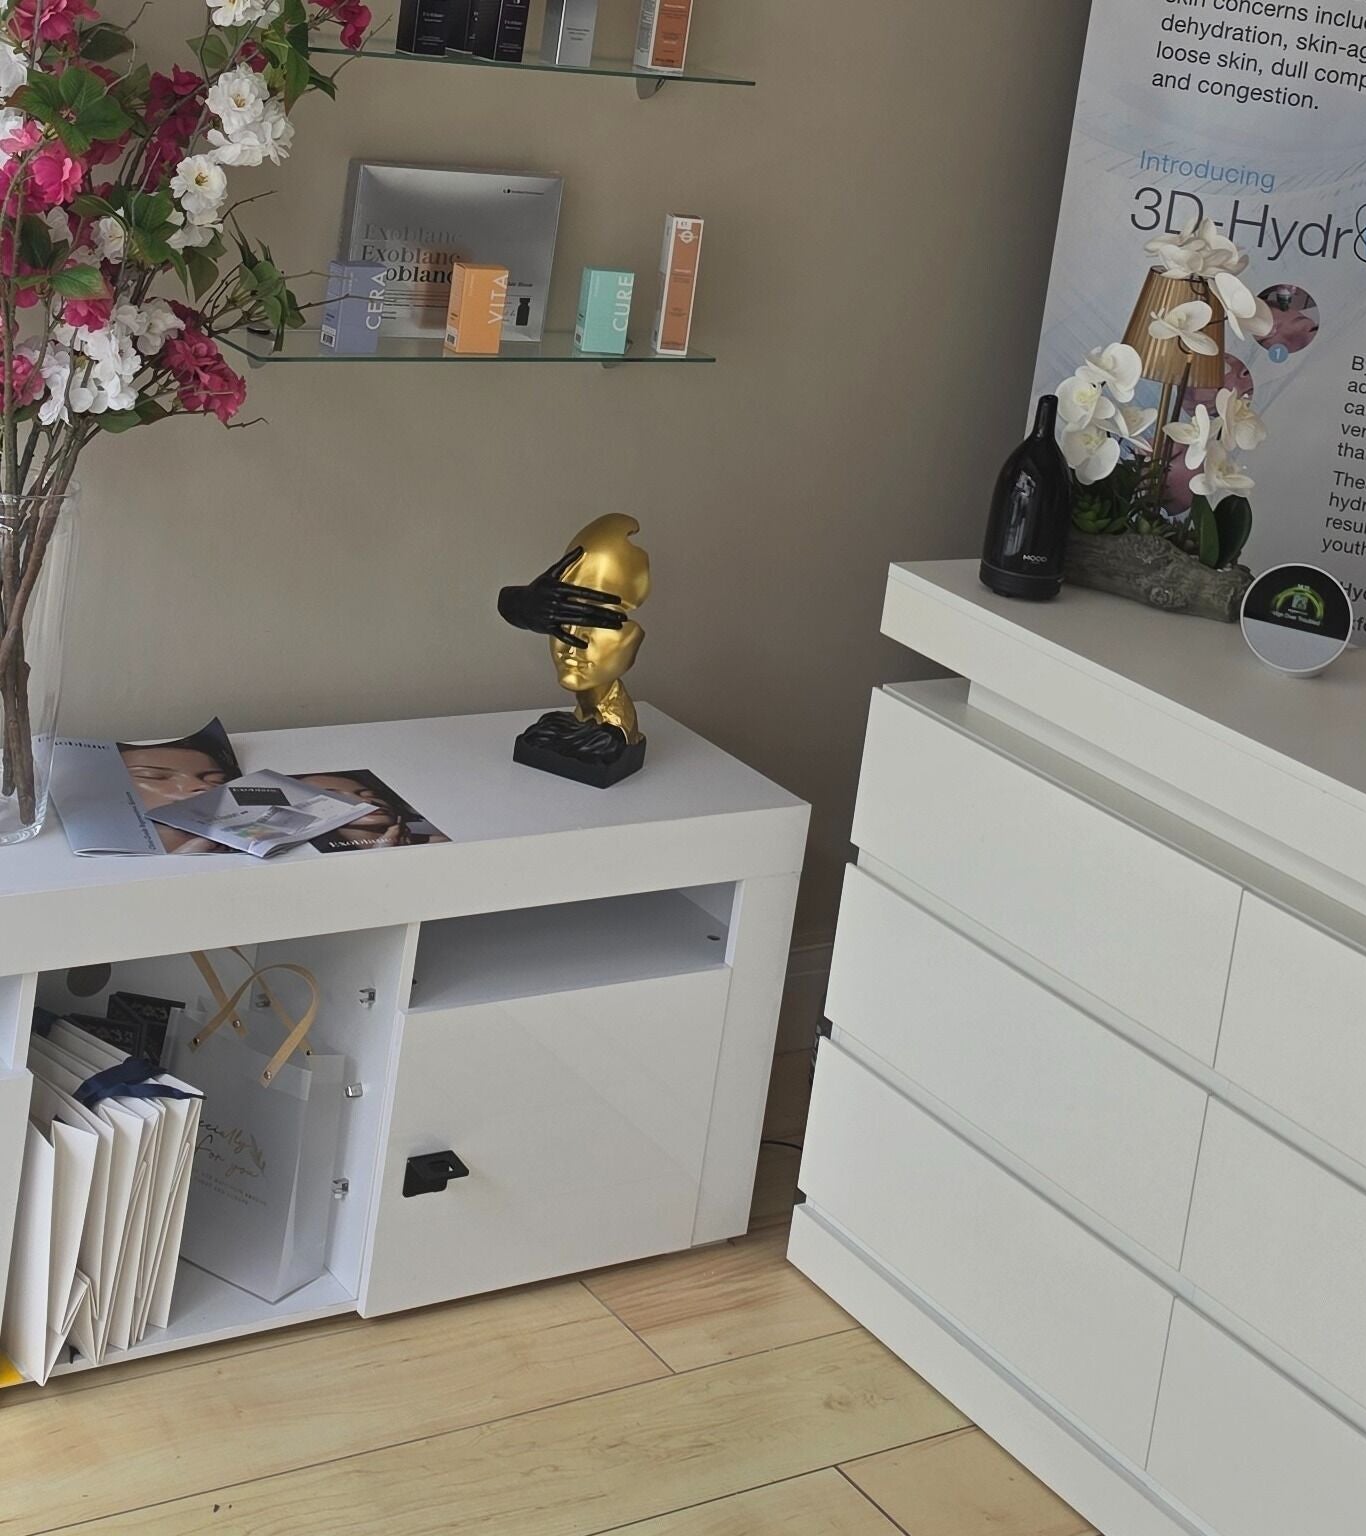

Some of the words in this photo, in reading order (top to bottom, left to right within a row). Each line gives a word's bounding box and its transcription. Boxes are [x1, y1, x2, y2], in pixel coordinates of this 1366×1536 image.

[1213, 0, 1308, 22] concerns
[1161, 13, 1288, 50] dehydration,
[1156, 41, 1211, 65] loose
[1217, 51, 1263, 76] skin,
[1271, 58, 1309, 79] dull
[1152, 72, 1191, 91] and
[1197, 79, 1320, 110] congestion.
[1140, 150, 1276, 194] Introducing
[361, 245, 460, 265] Exoblanc
[365, 269, 388, 330] CERA
[487, 273, 509, 325] VITA
[612, 275, 634, 332] CURE
